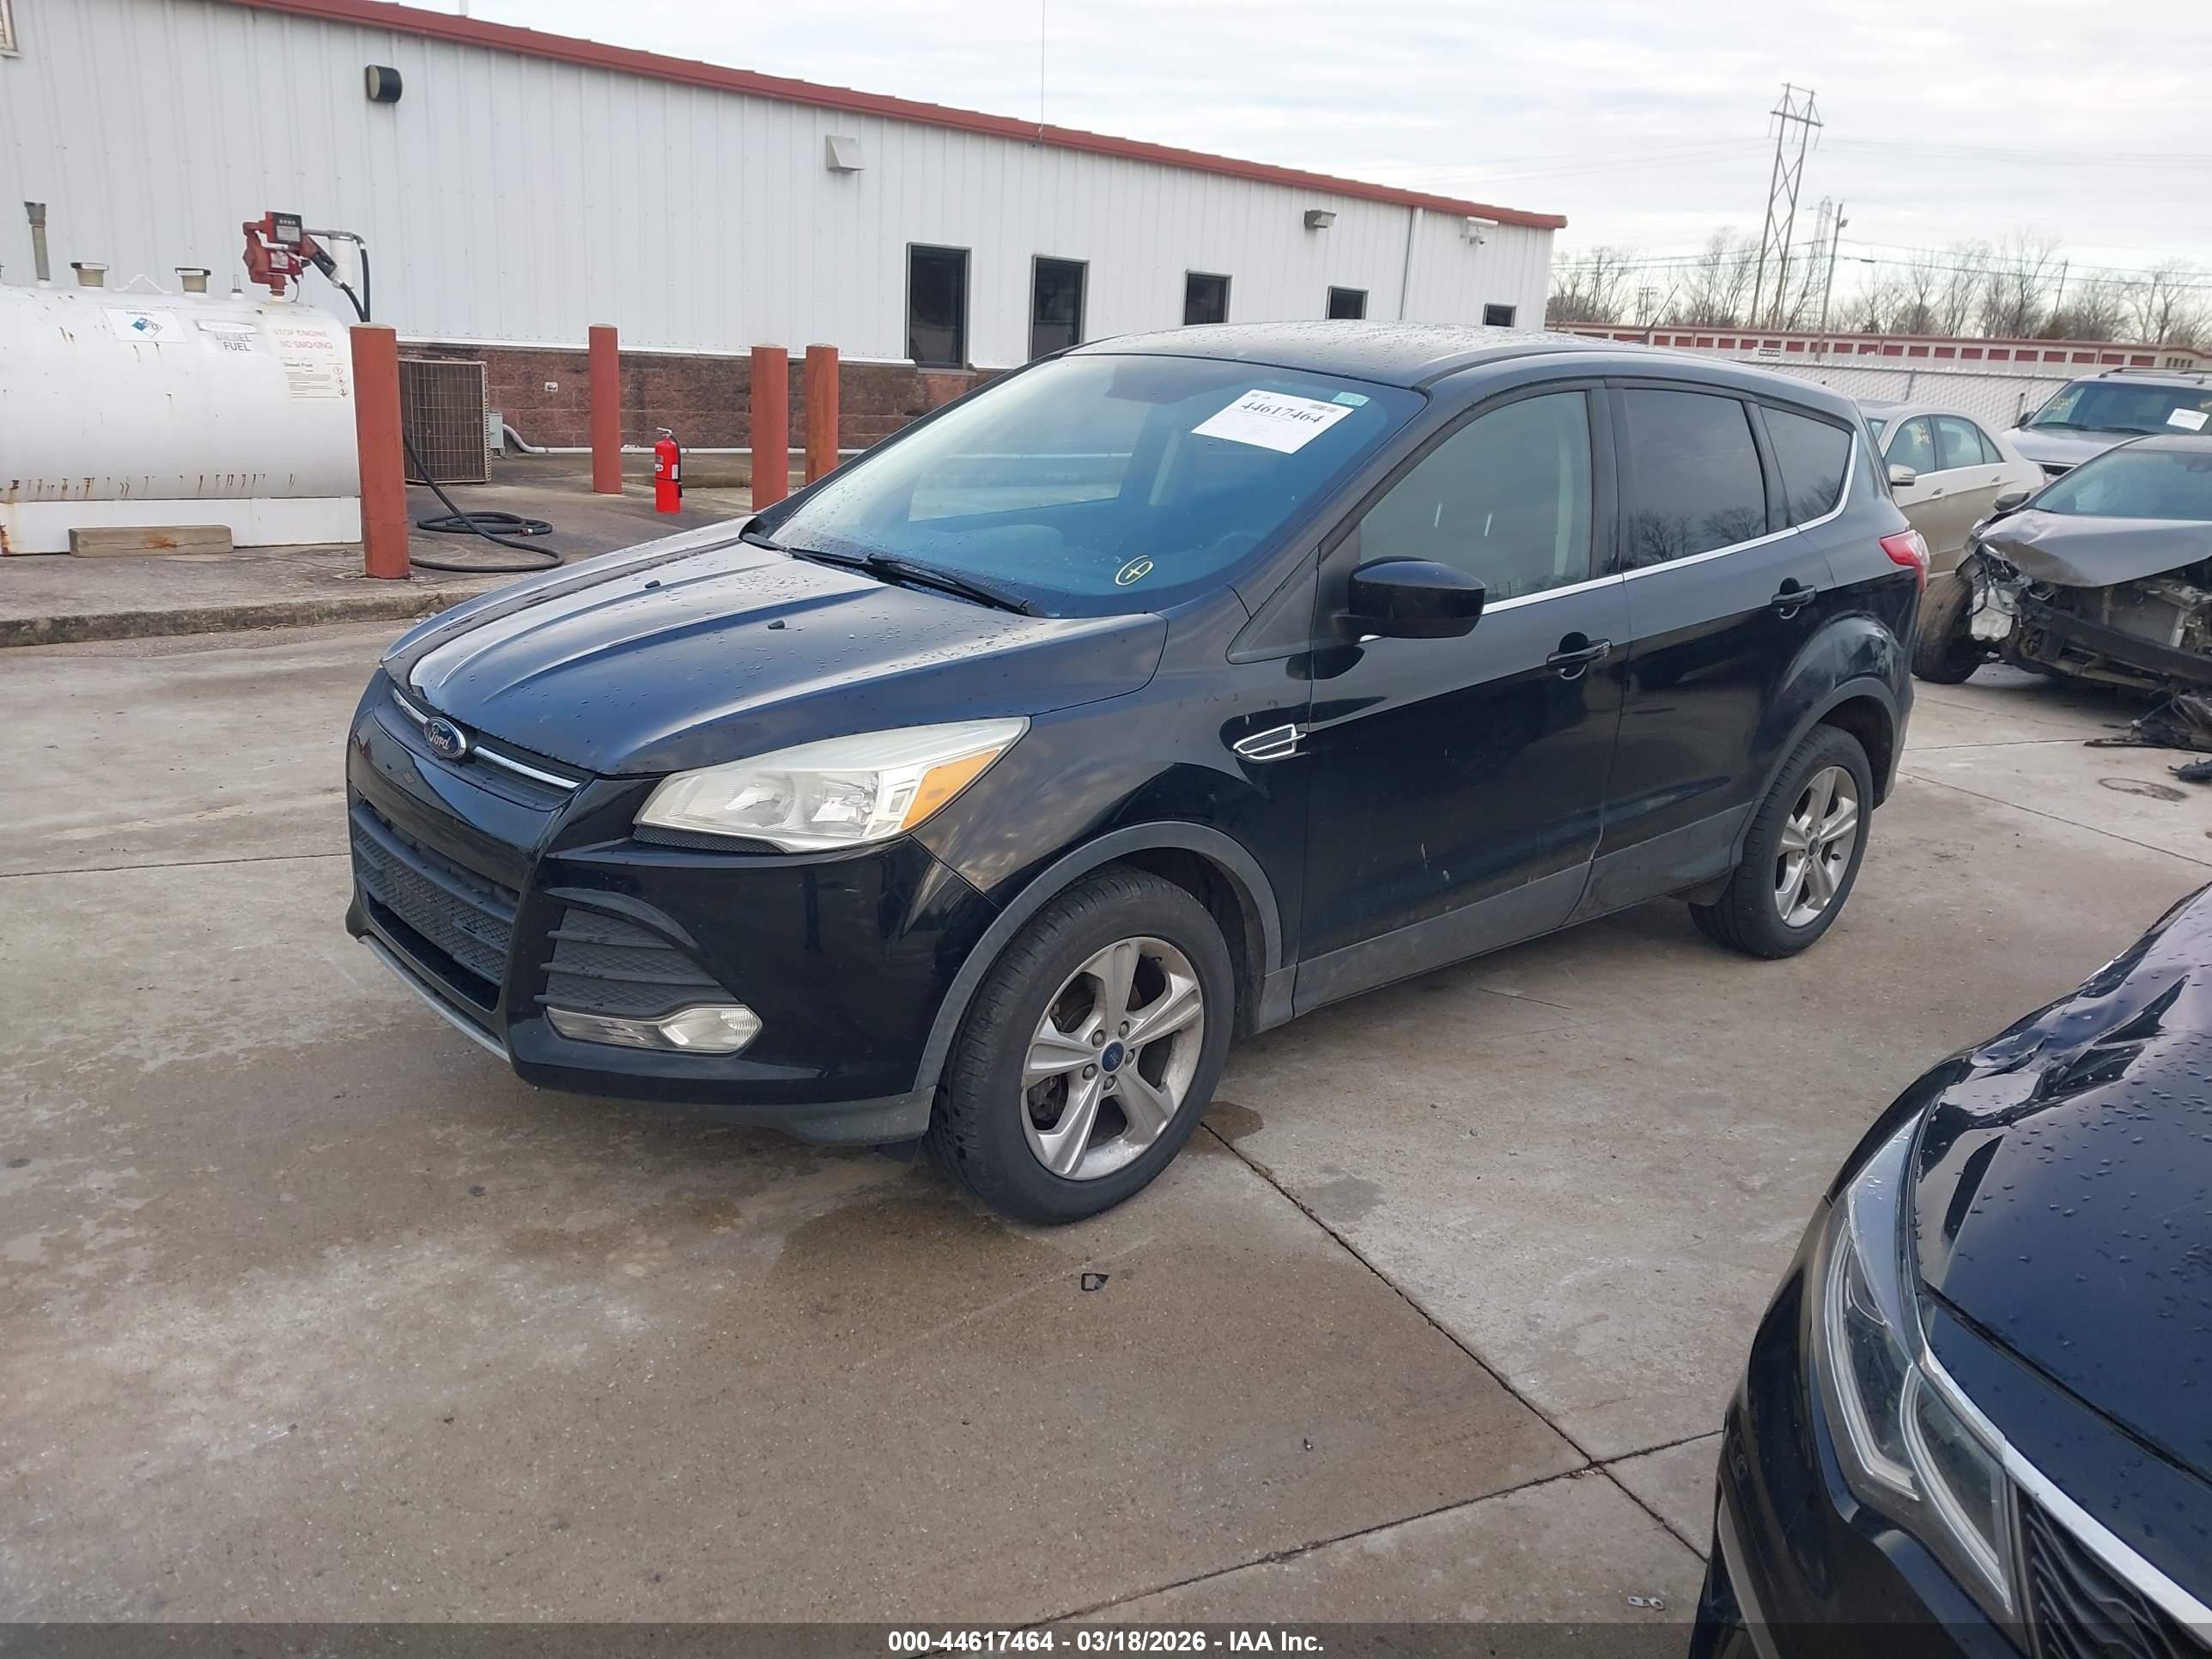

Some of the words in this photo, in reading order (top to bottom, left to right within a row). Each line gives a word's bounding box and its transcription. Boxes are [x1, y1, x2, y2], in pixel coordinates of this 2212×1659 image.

[223, 342, 252, 351] FUEL
[1241, 401, 1325, 424] 44617464
[428, 721, 453, 750] Ford
